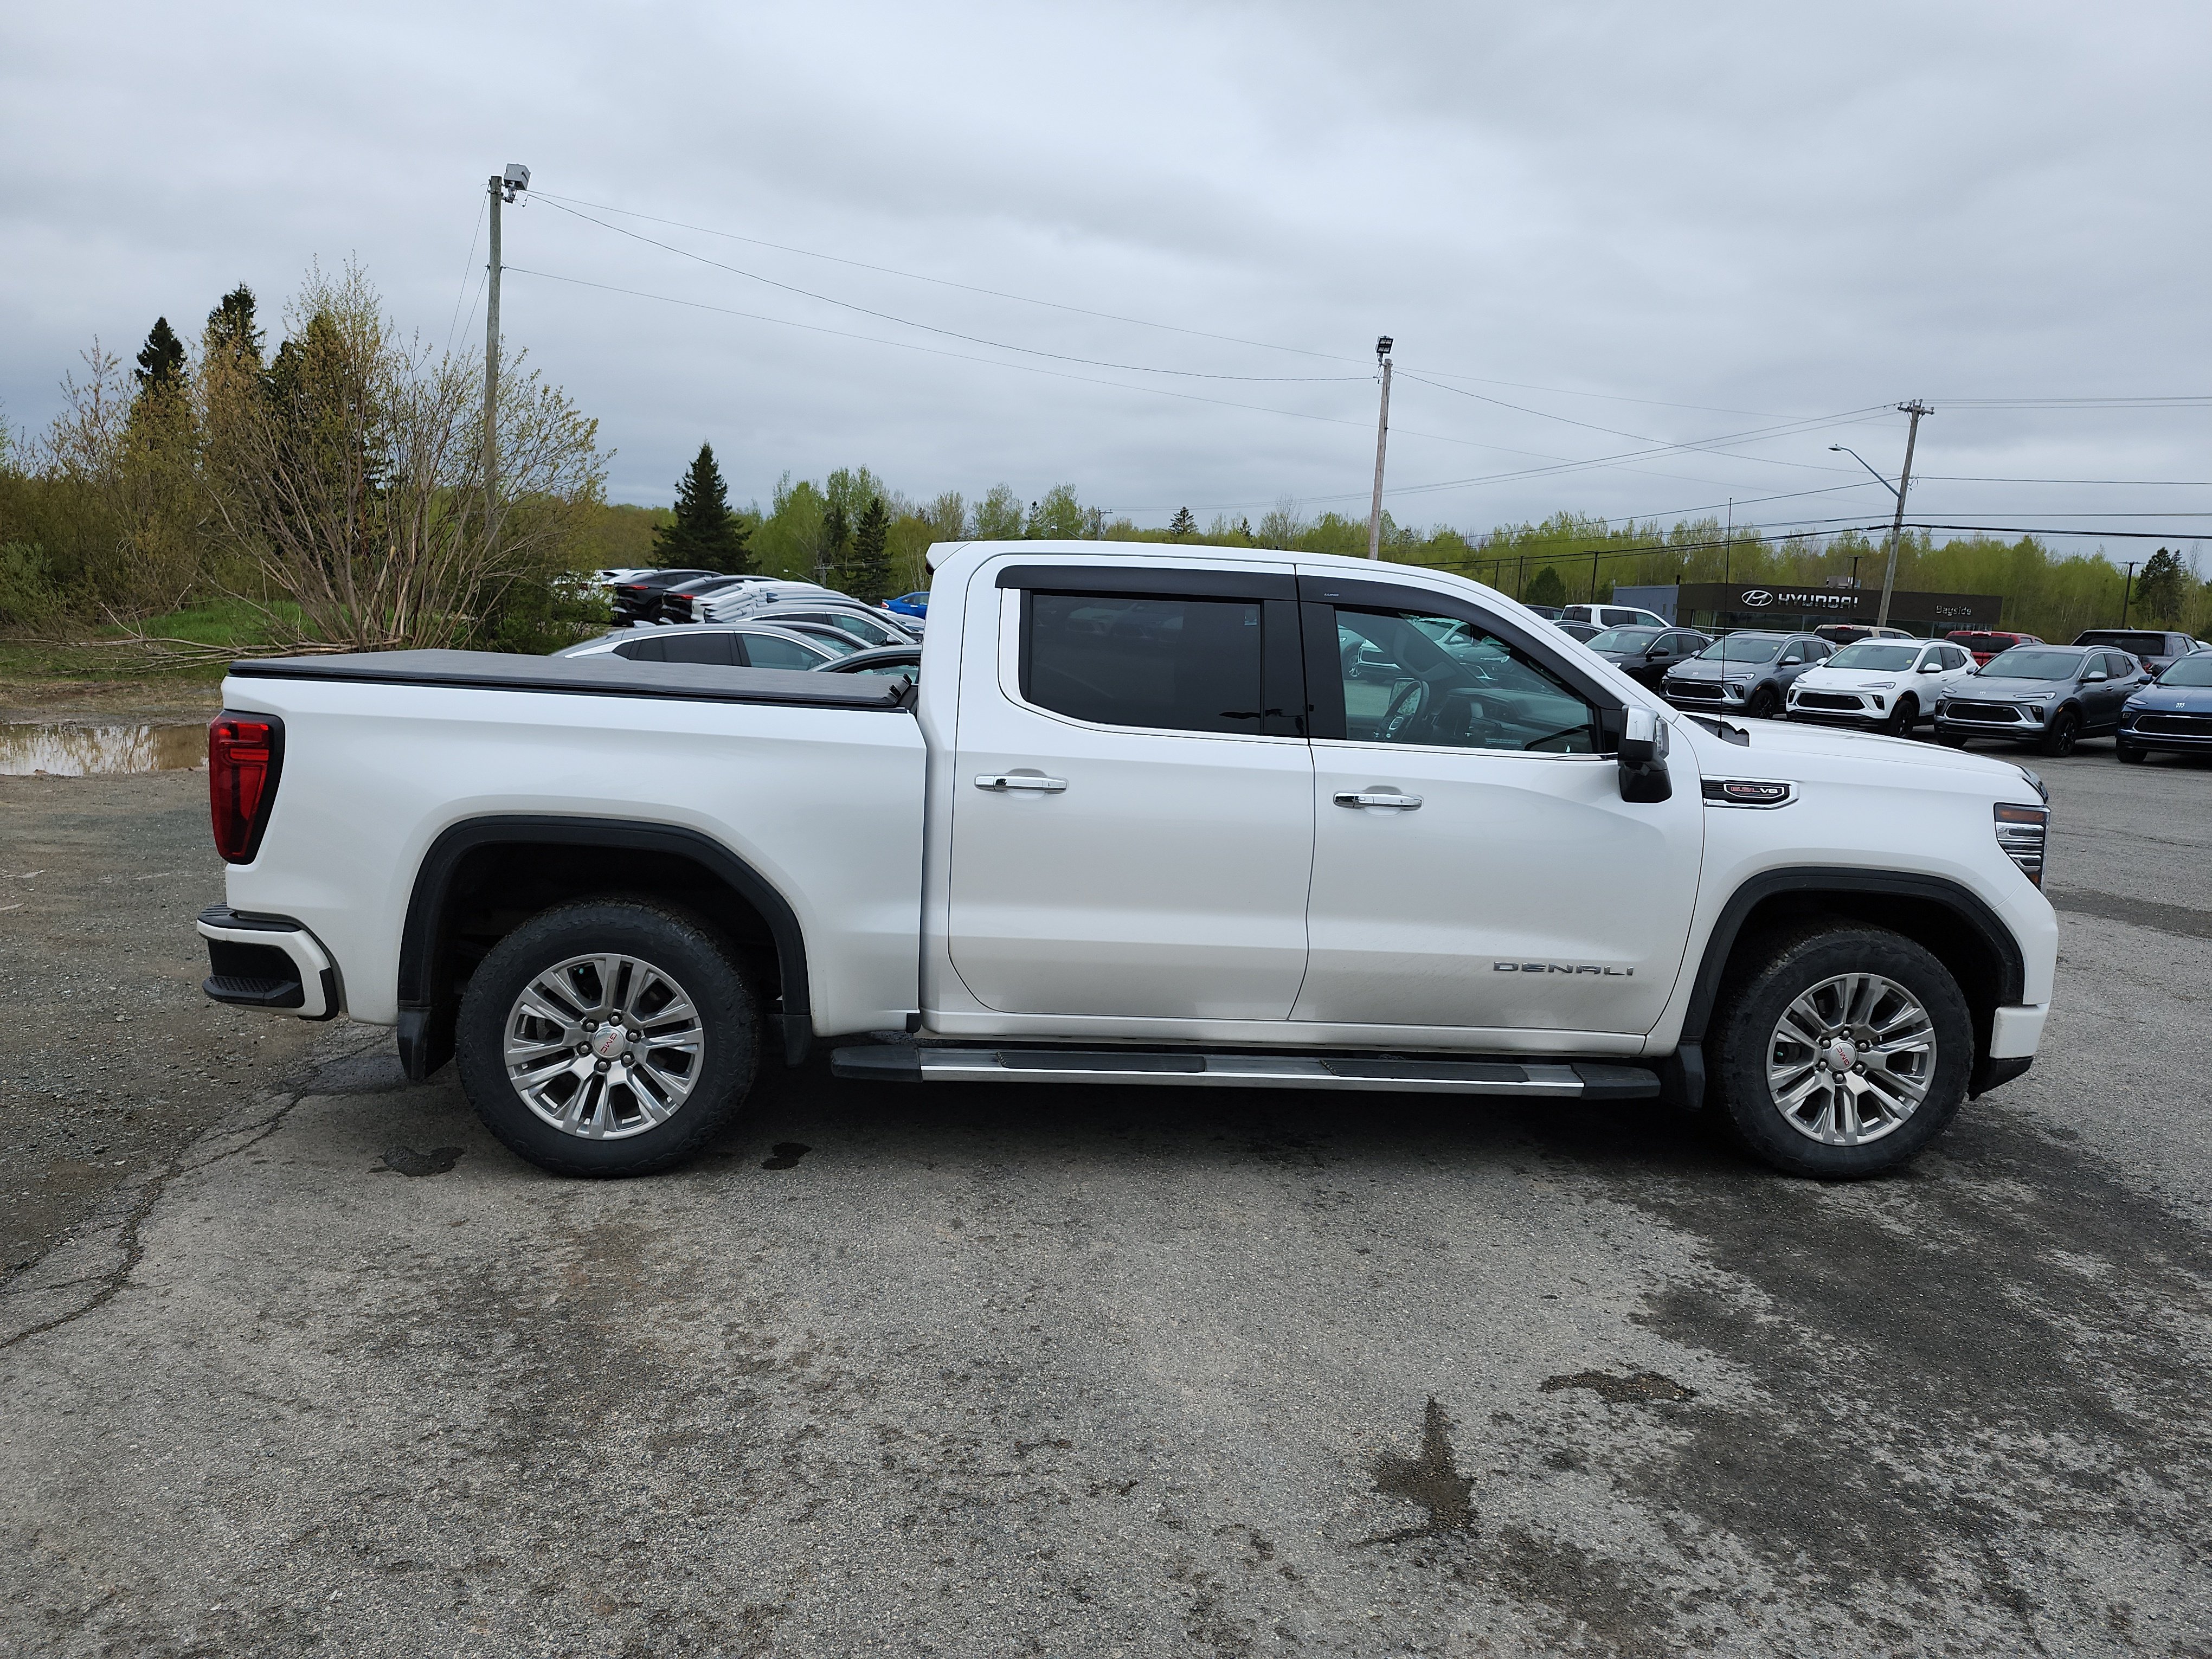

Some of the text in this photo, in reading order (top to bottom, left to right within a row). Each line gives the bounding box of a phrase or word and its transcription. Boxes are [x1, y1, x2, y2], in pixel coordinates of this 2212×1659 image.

[1778, 593, 1859, 609] HYUNDAI
[1936, 605, 1971, 616] Bayside
[1493, 961, 1634, 975] DENALI
[600, 1032, 618, 1053] GMC
[1836, 1046, 1850, 1066] GMC
